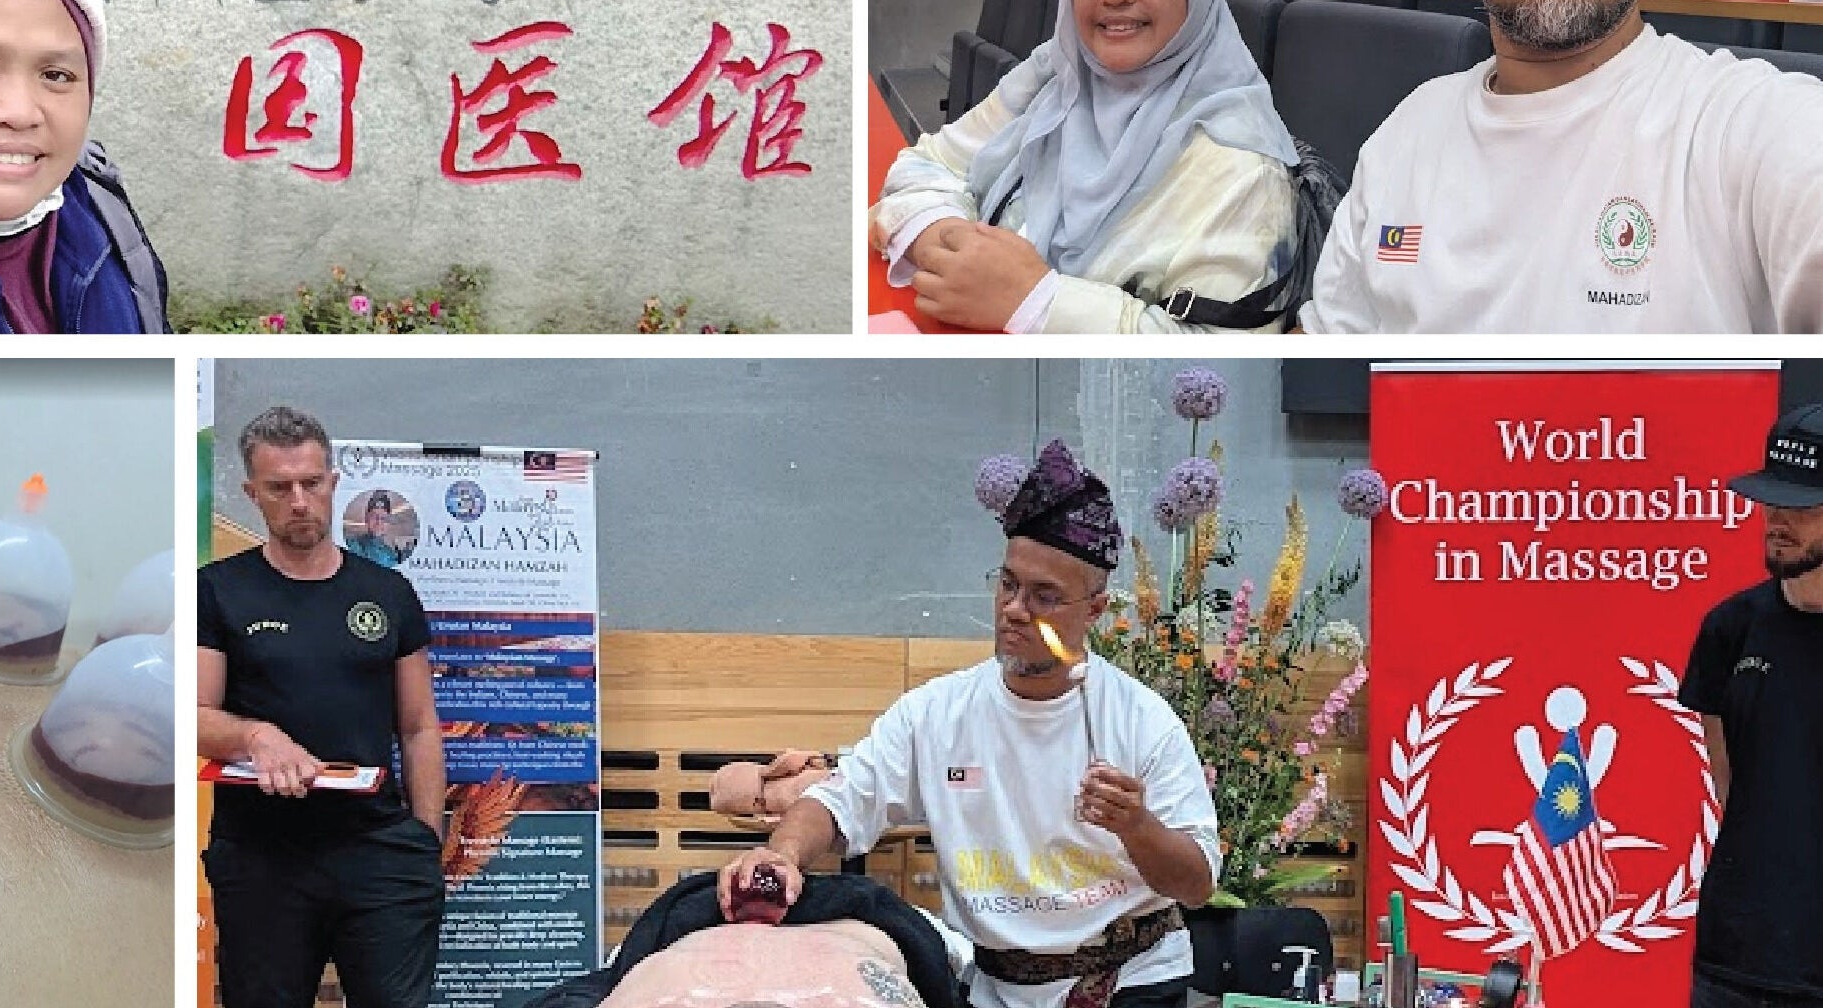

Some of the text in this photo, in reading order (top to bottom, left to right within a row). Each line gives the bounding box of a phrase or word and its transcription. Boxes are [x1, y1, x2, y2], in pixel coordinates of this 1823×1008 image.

[1495, 417, 1647, 463] World
[1390, 476, 1755, 532] Championship
[426, 524, 583, 553] MALAYSIA
[408, 556, 569, 573] MAHADIZAN HAMZAH
[1434, 541, 1709, 591] in Massage
